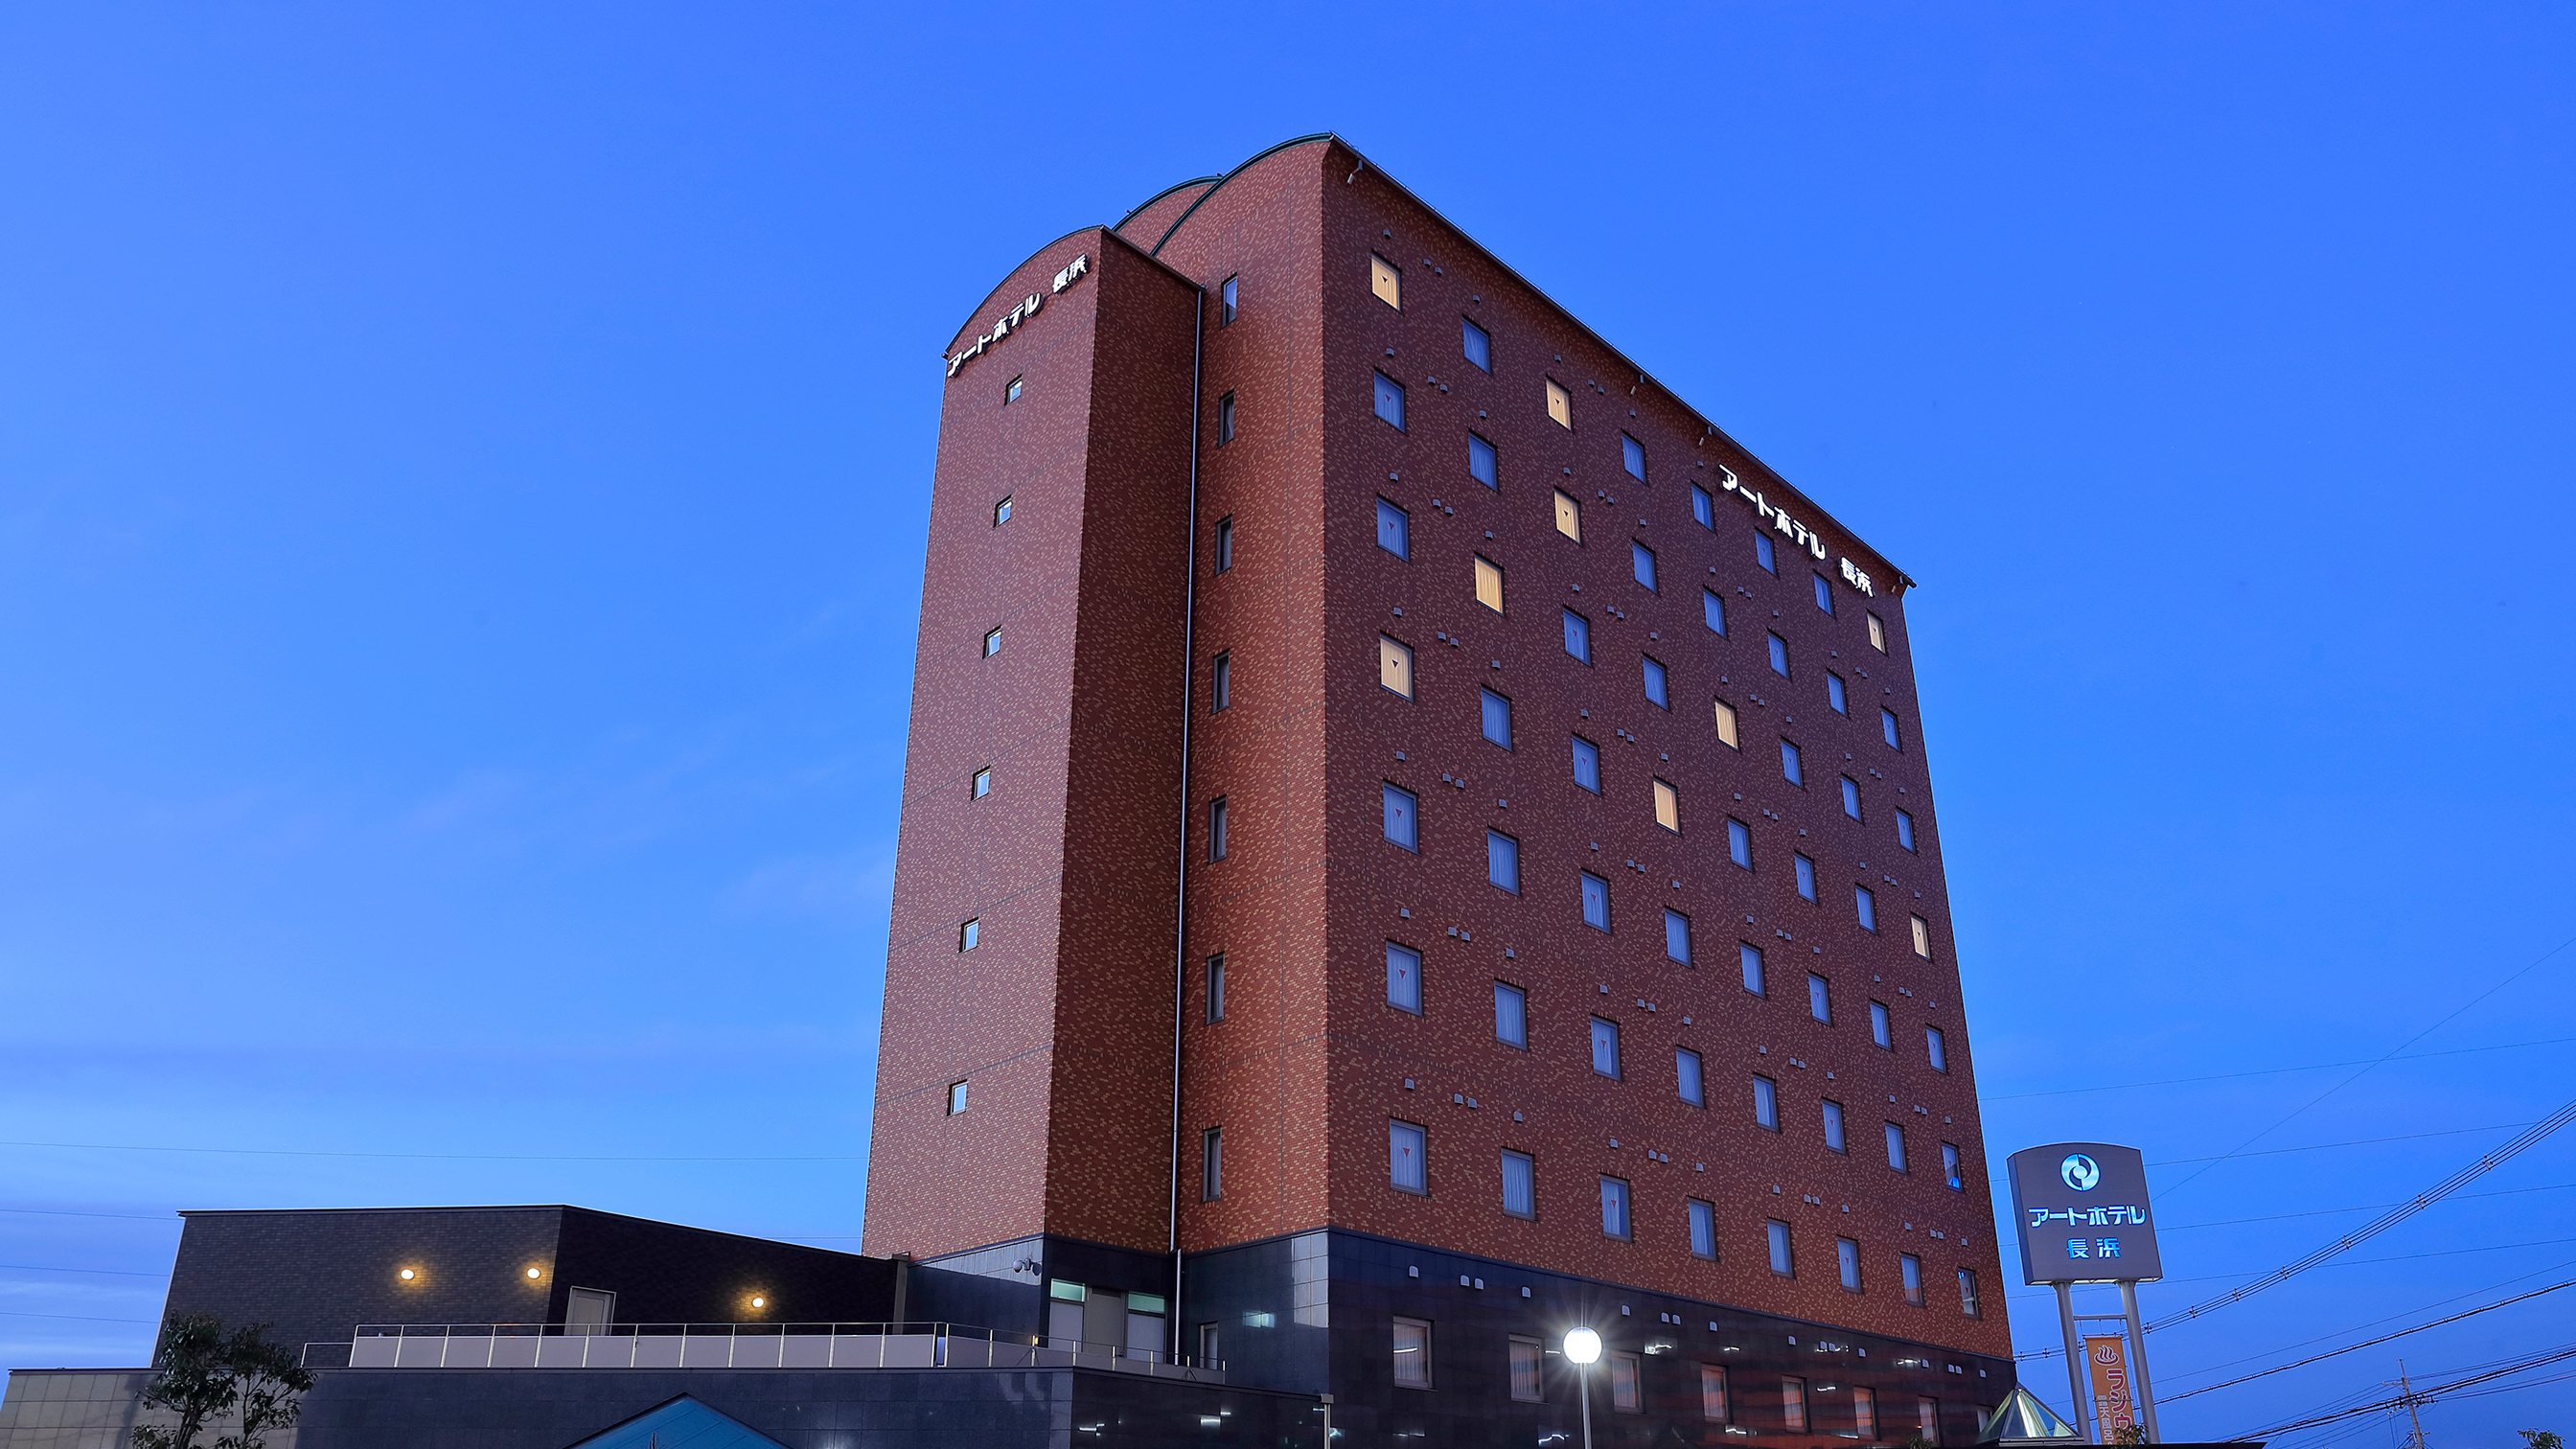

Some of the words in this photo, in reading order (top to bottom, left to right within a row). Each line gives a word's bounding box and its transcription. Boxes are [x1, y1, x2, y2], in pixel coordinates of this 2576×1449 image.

[947, 292, 1042, 377] アートホテル
[1052, 254, 1088, 293] 長浜
[1718, 463, 1826, 560] アートホテル
[1840, 556, 1874, 597] 長浜
[2028, 1205, 2147, 1228] アートホテル
[2066, 1237, 2121, 1259] 長浜
[2106, 1368, 2133, 1444] ラジウ
